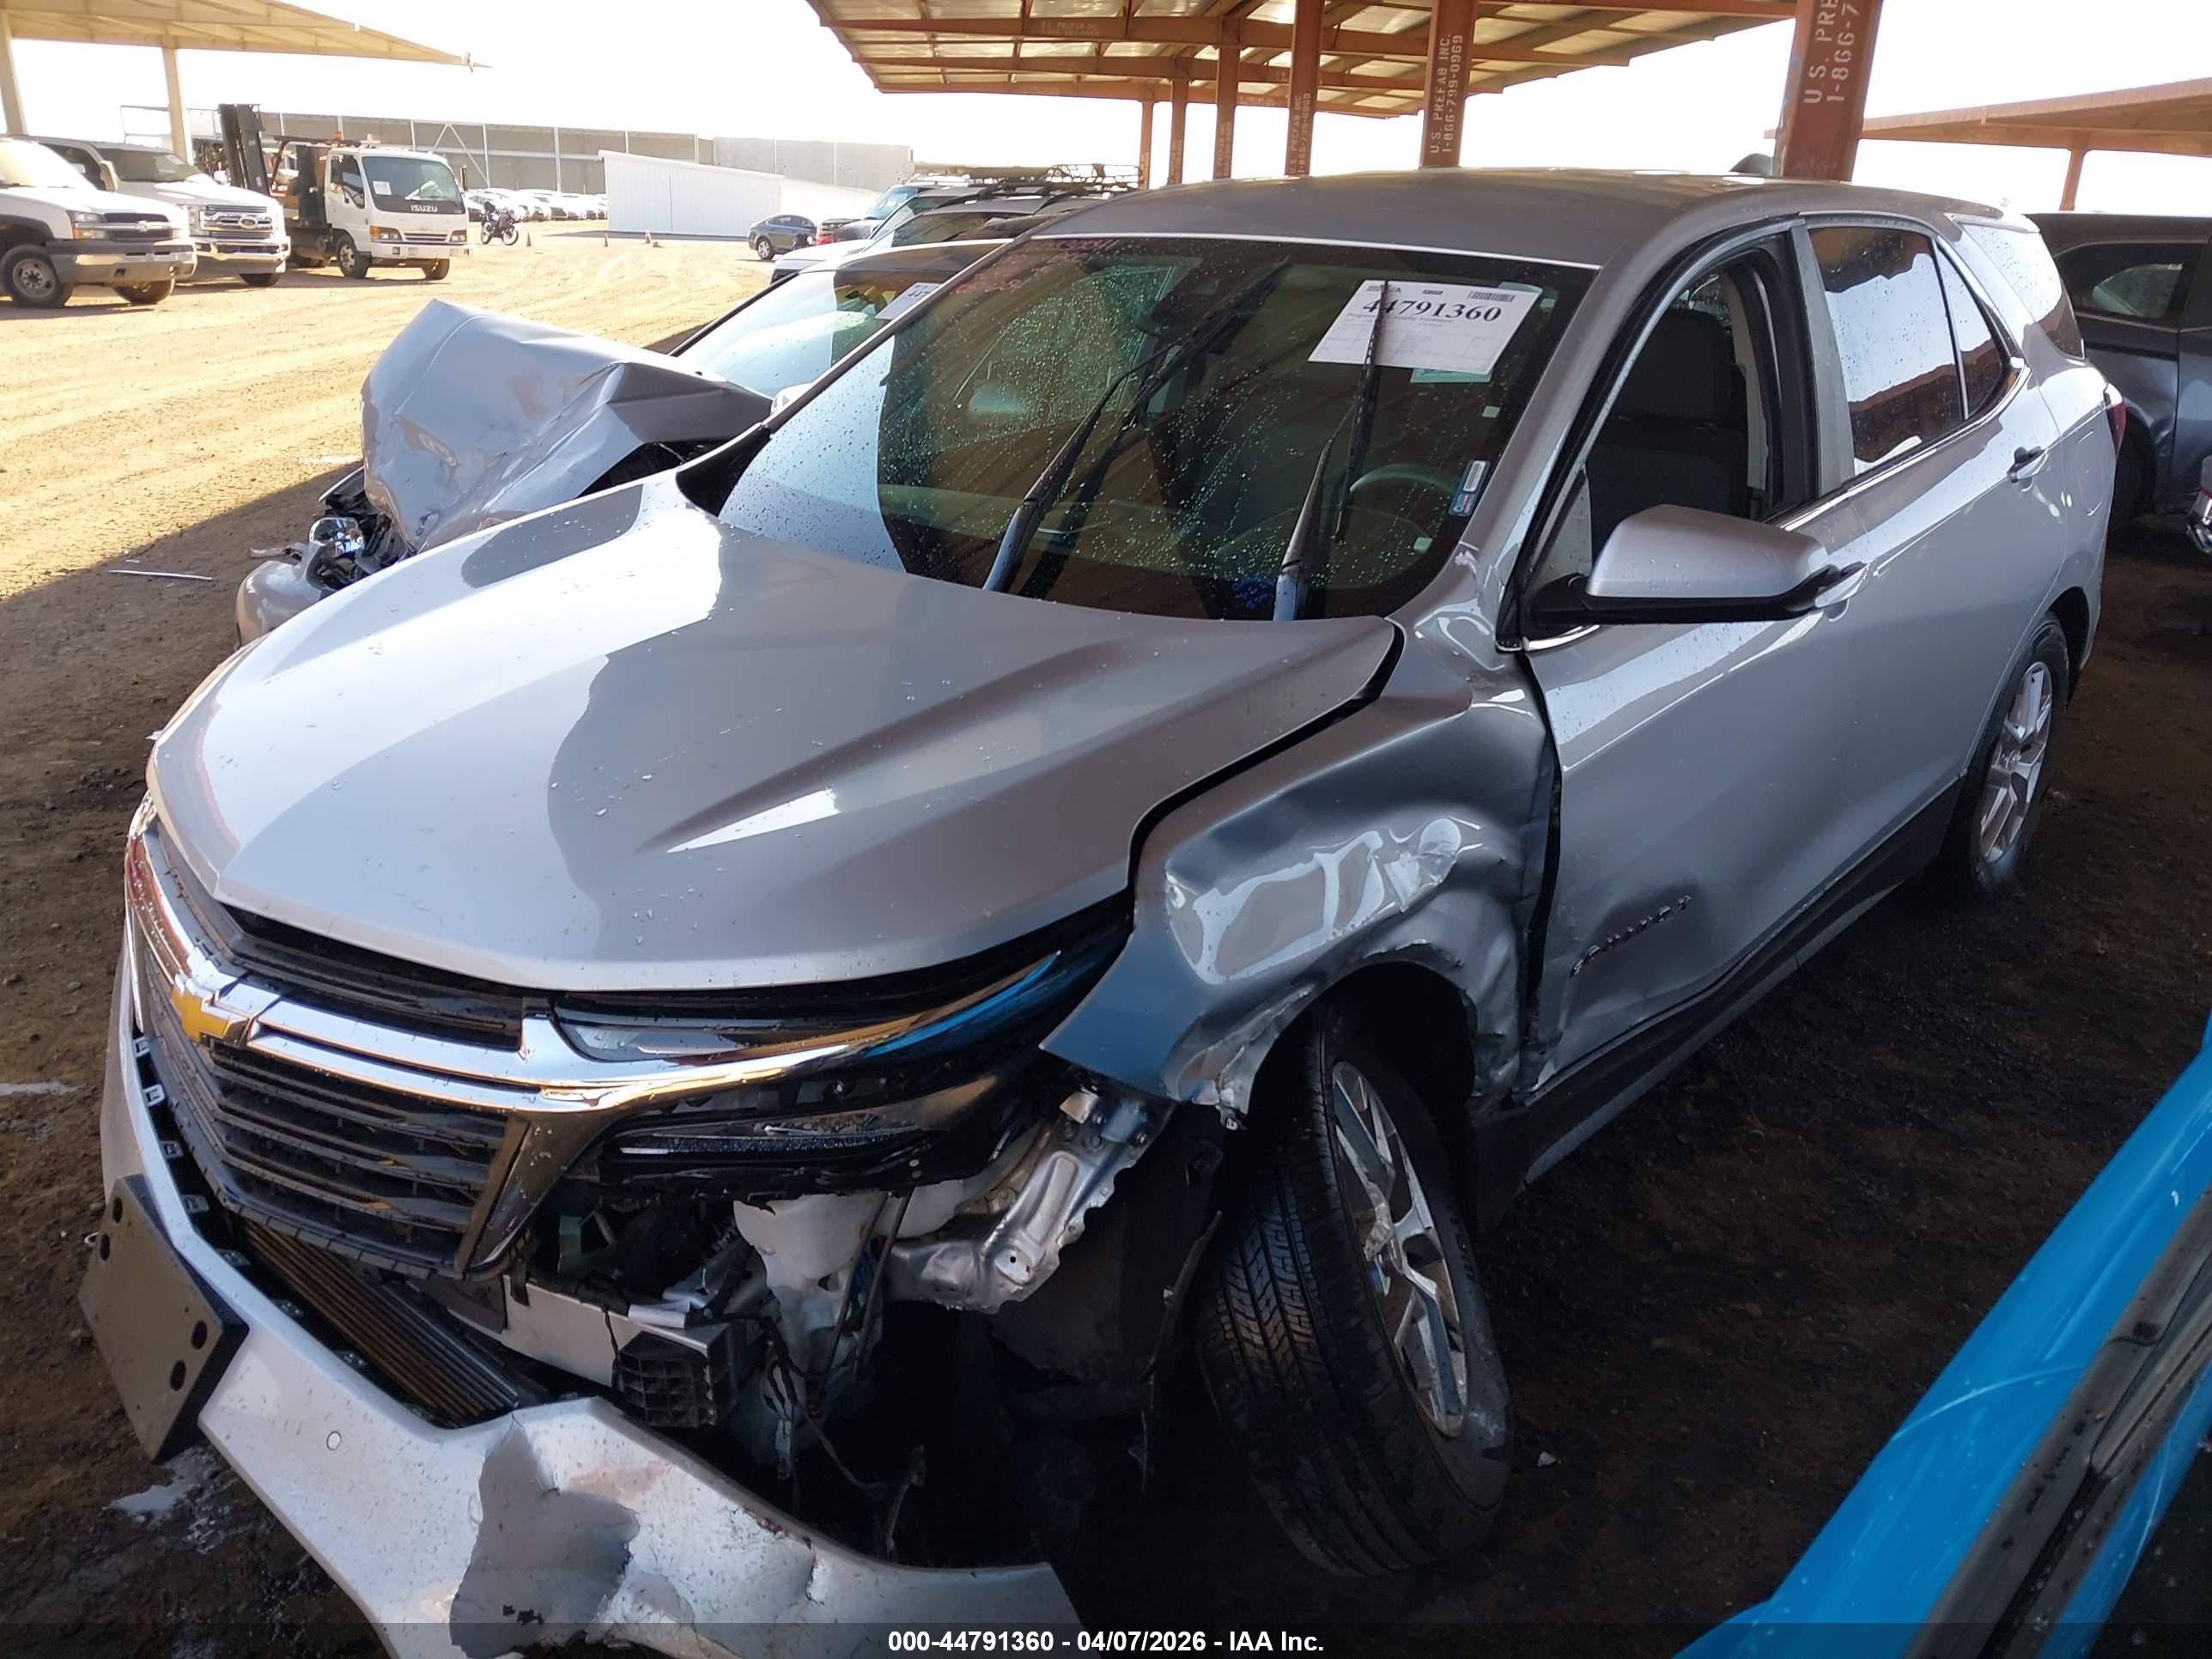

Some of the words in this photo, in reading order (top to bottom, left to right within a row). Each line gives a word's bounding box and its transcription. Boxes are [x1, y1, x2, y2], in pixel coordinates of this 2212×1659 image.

[1433, 67, 1448, 120] PREFAB
[1442, 34, 1463, 152] 1-866-799-0969
[410, 204, 438, 213] ISUZU
[1363, 297, 1502, 322] 44791360
